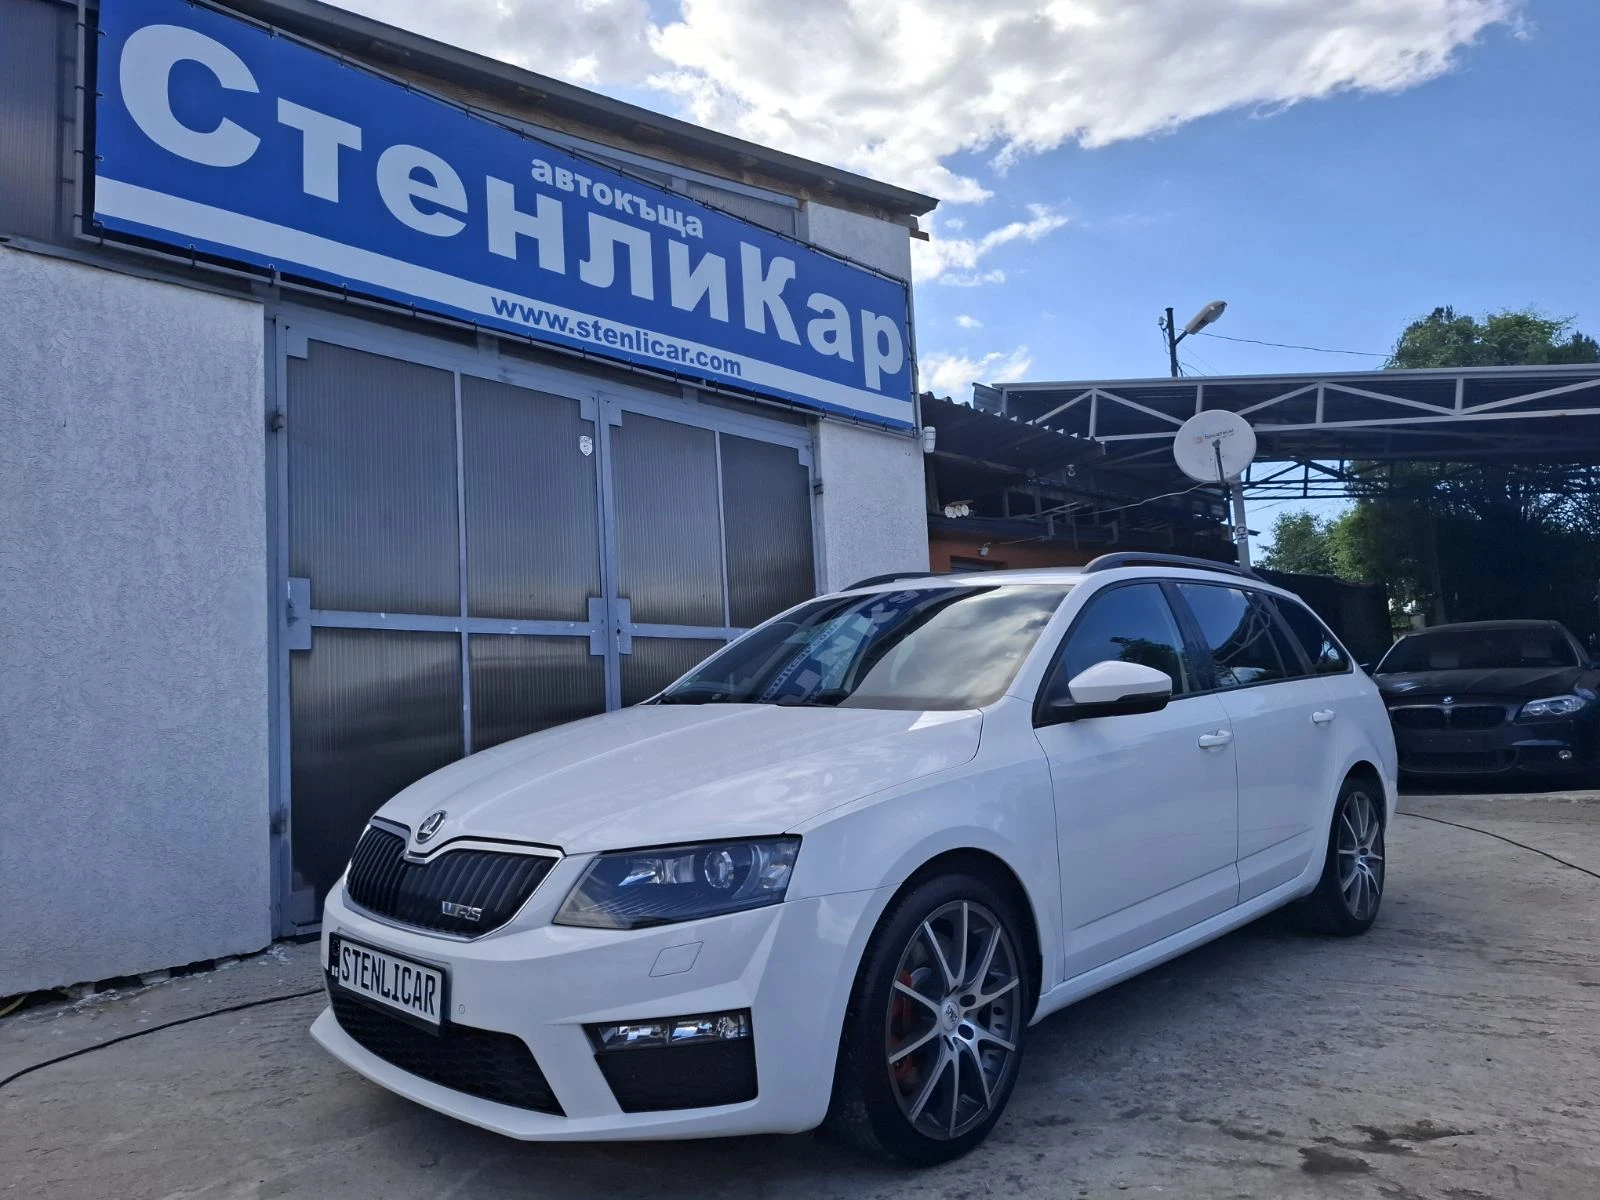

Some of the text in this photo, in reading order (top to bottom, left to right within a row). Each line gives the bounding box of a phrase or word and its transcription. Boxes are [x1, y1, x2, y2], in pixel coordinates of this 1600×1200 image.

[119, 24, 904, 390] СтенлиКар
[531, 158, 704, 239] автокъща
[491, 296, 742, 377] www.stenlicar.com
[341, 946, 436, 1016] STENLICAR
